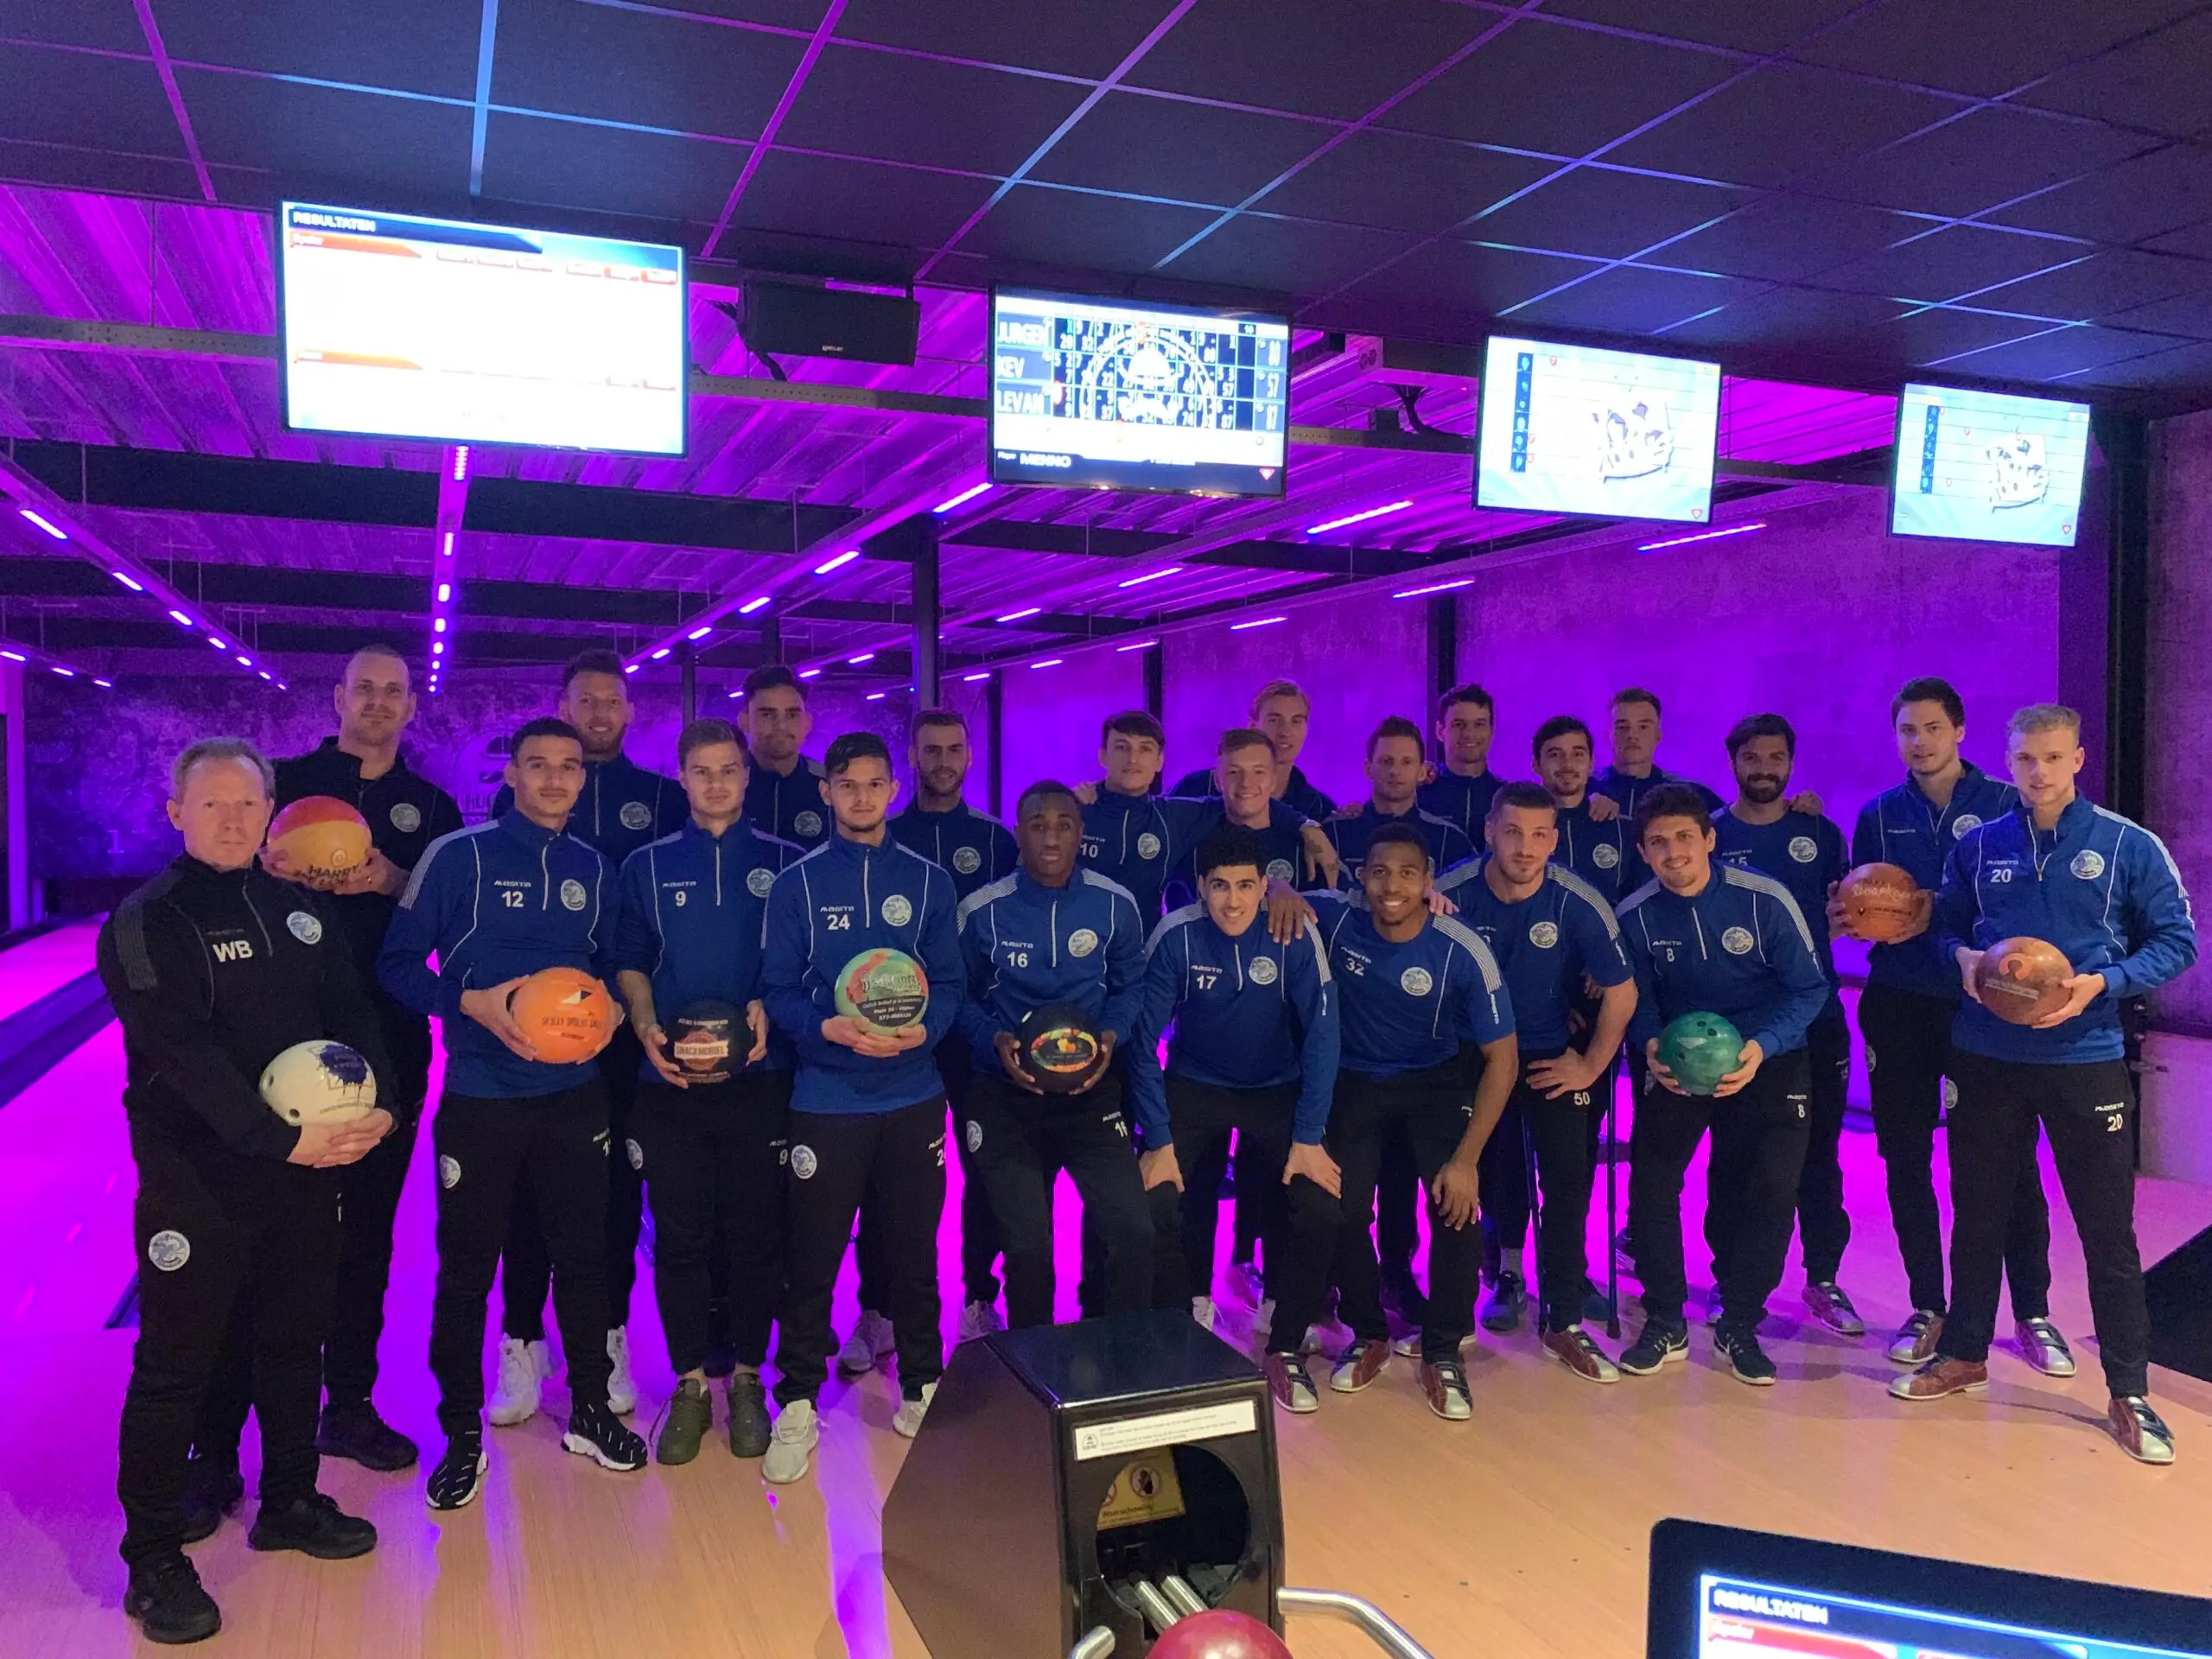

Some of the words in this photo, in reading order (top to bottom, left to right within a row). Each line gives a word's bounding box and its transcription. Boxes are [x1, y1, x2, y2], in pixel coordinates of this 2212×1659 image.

[1080, 842, 1098, 858] 10
[1990, 868, 2012, 883] 20
[502, 891, 524, 907] 12
[675, 891, 686, 906] 9
[827, 914, 851, 931] 24
[213, 940, 253, 963] WB
[1007, 951, 1028, 968] 16
[1666, 948, 1675, 962] 8
[1345, 957, 1365, 976] 32
[1197, 975, 1217, 989] 17
[1574, 1092, 1591, 1106] 50
[1797, 1104, 1805, 1118] 8
[2107, 1114, 2123, 1132] 20
[779, 1148, 788, 1166] 9
